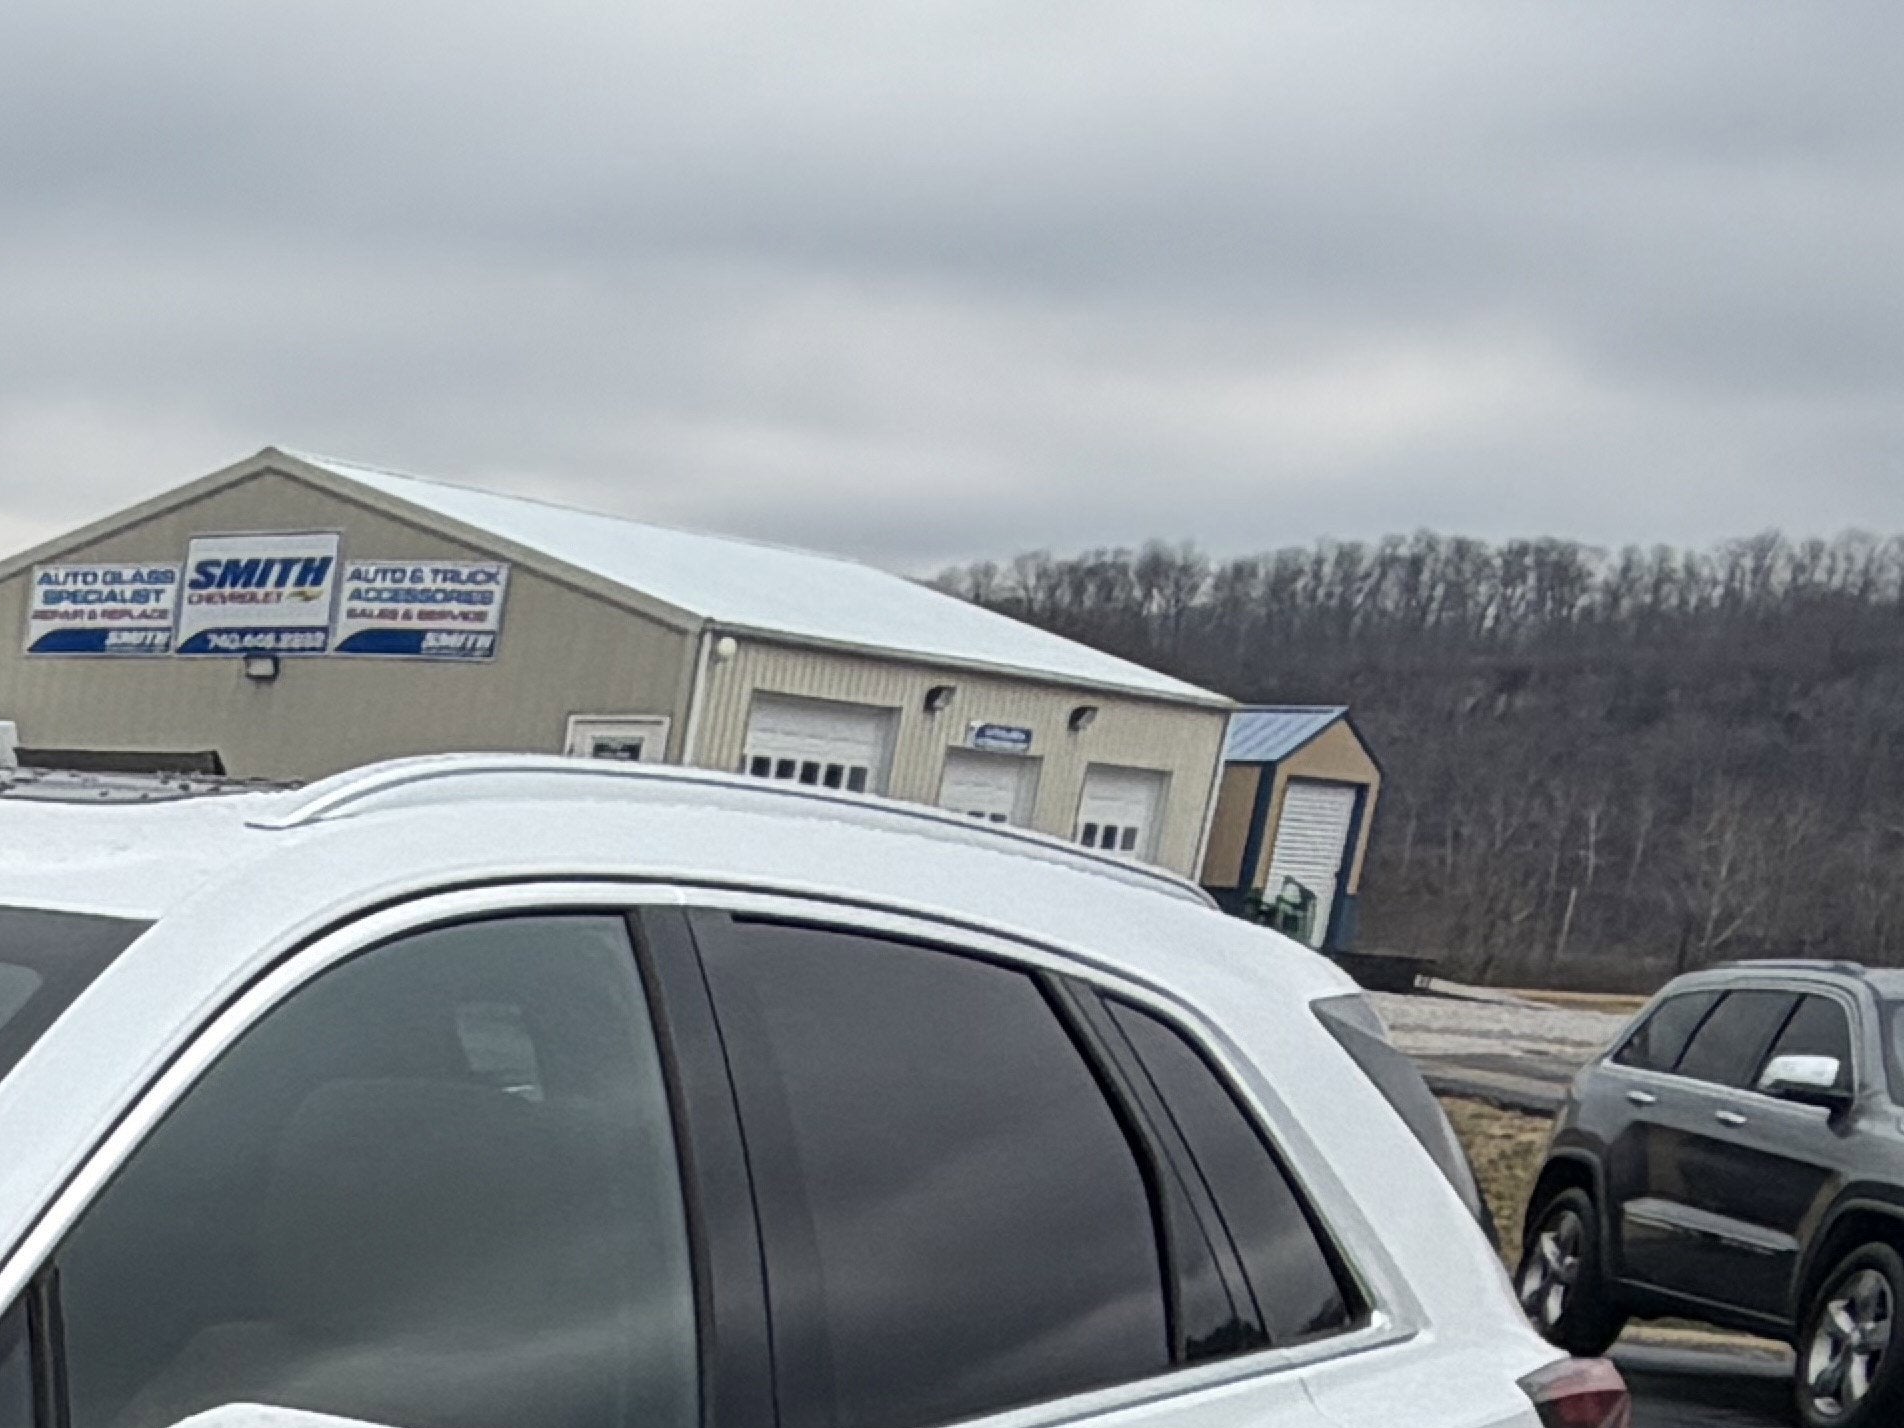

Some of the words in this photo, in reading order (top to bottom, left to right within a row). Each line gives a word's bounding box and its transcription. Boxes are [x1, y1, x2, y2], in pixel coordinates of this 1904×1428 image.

[37, 571, 98, 586] AUTO
[102, 569, 176, 586] GLASS
[188, 557, 334, 590] SMITH
[347, 567, 407, 584] AUTO
[409, 567, 424, 584] &
[430, 568, 500, 585] TRUCK
[42, 588, 166, 606] SPECIALIST
[188, 590, 284, 606] CHEVROLET
[348, 587, 494, 606] ACCESSORIES
